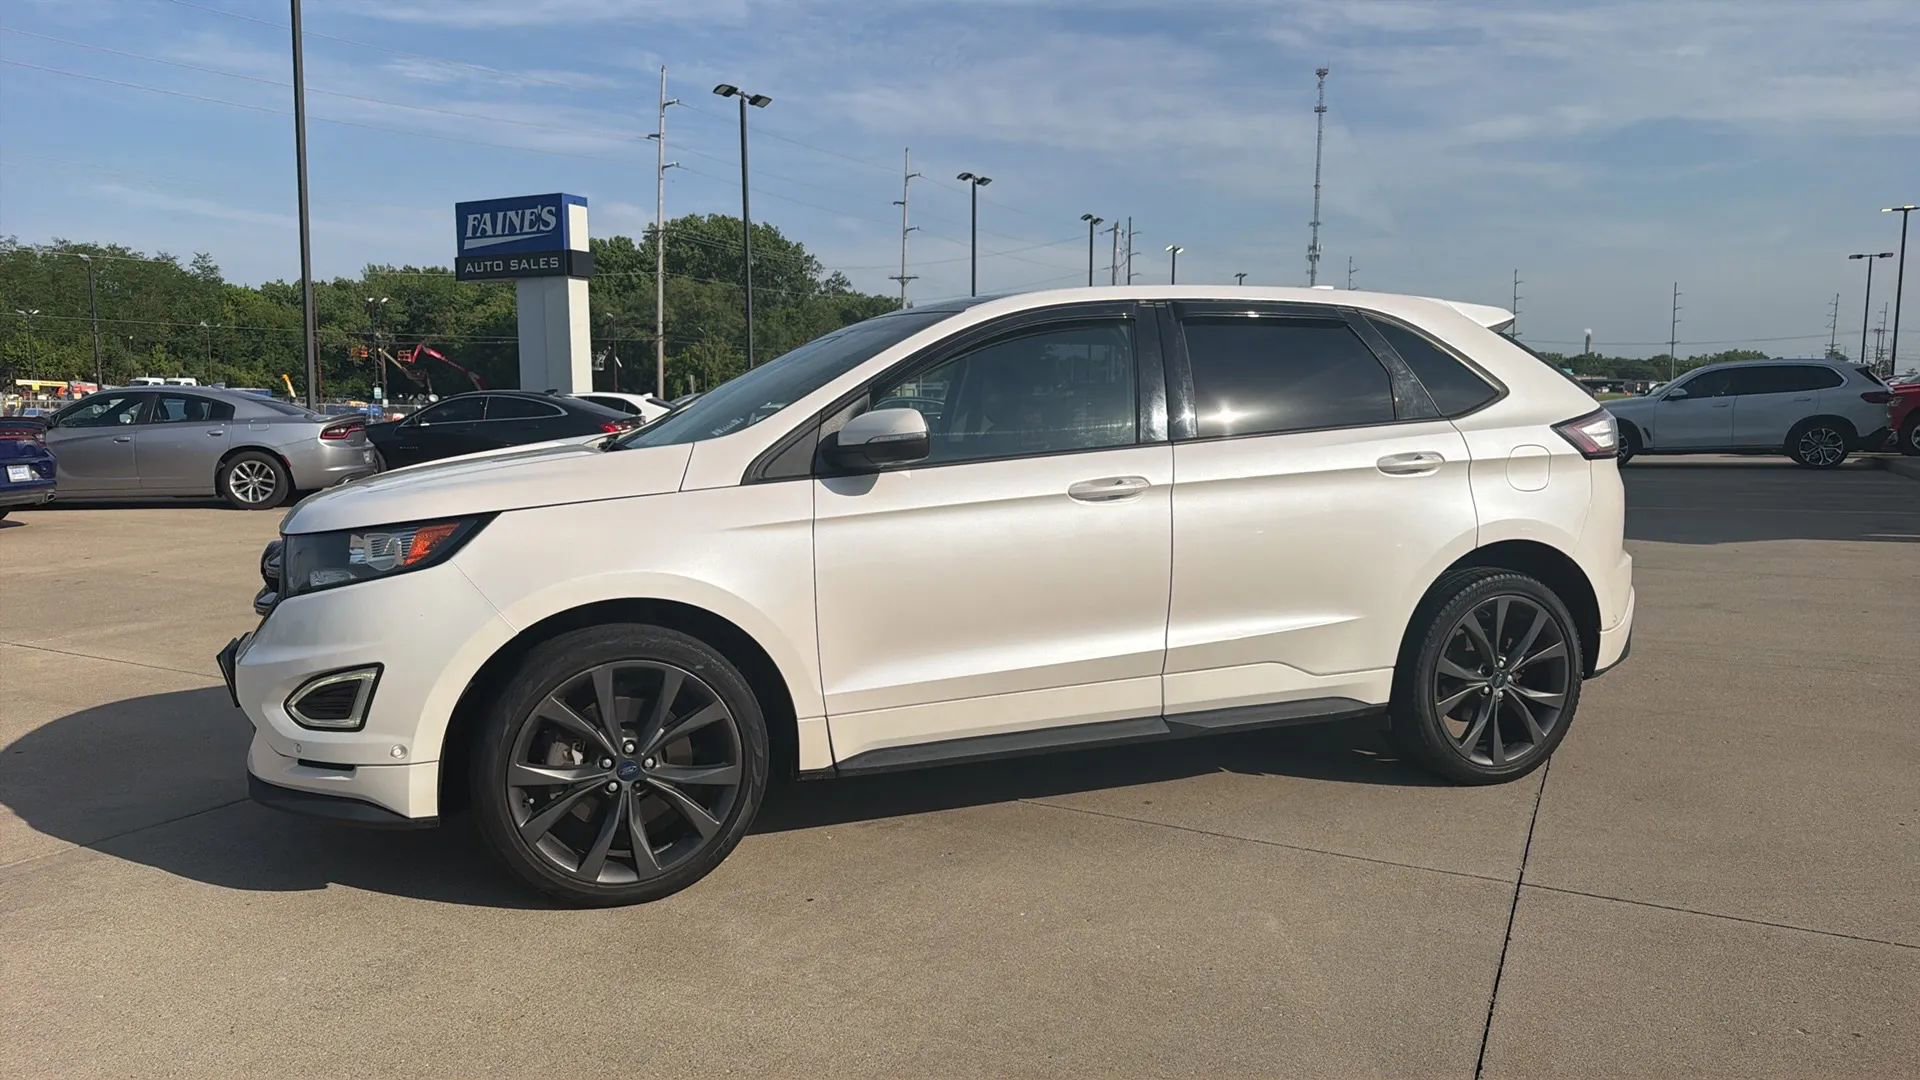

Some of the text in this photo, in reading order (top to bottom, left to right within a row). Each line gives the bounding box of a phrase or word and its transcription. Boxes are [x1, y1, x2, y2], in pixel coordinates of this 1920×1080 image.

[466, 205, 557, 237] FAINE'S
[465, 257, 559, 273] AUTO SALES
